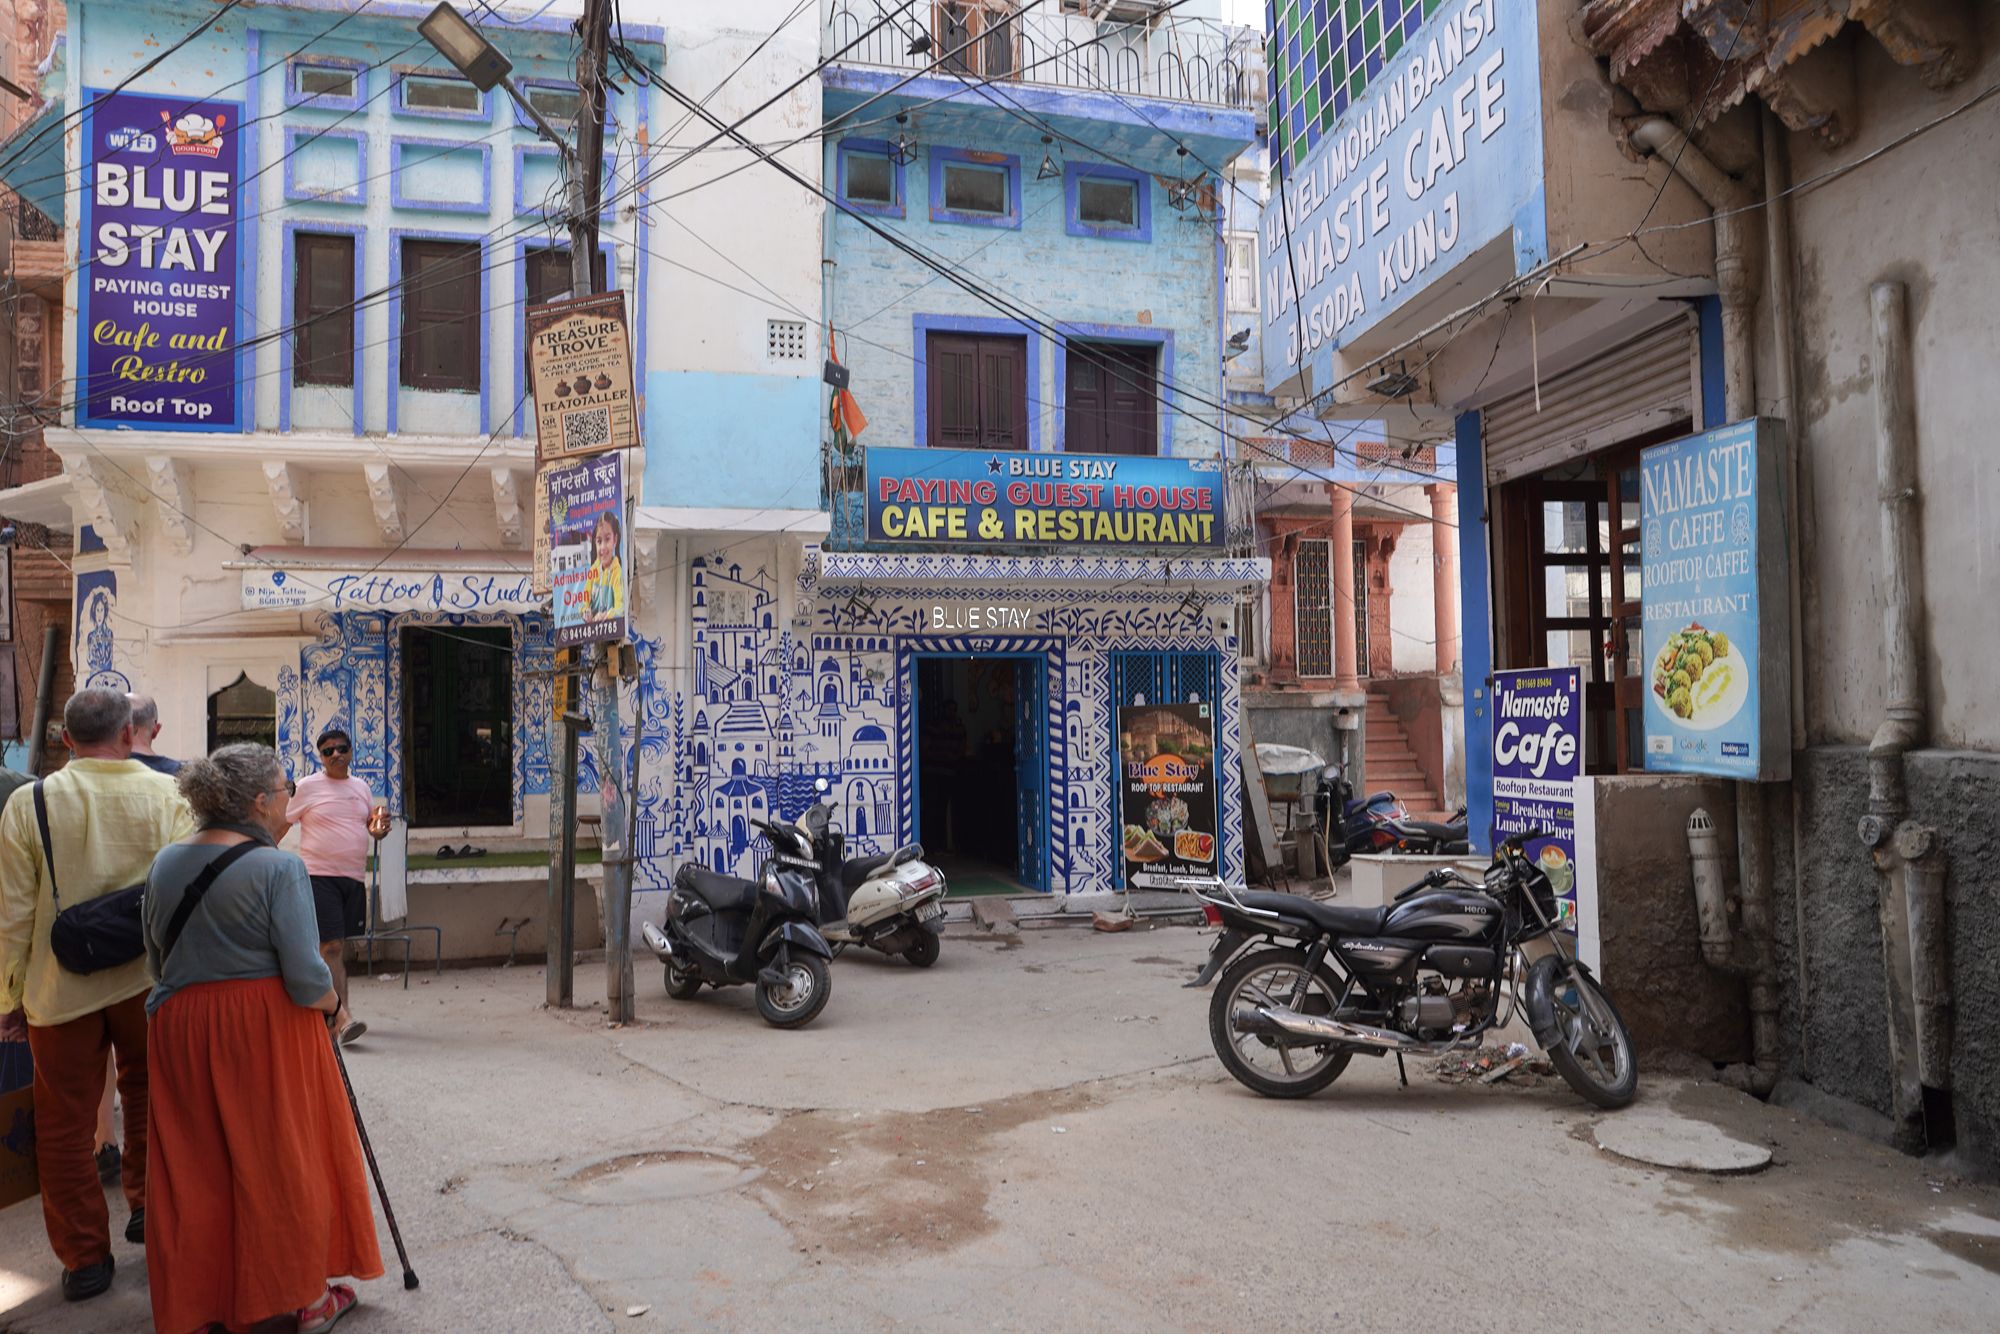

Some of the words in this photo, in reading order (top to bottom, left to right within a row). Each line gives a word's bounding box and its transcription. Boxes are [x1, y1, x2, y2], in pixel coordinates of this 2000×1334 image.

[97, 162, 229, 215] BLUE
[1266, 159, 1390, 327] NAMASTE
[1403, 48, 1506, 201] CAFE
[97, 221, 228, 273] STAY
[94, 277, 163, 297] PAYING
[169, 282, 231, 300] GUEST
[1287, 271, 1366, 368] JASODA
[1378, 191, 1460, 301] KUNJ
[133, 300, 198, 318] HOUSE
[93, 319, 161, 352] Cafe
[169, 326, 228, 351] and
[536, 320, 620, 346] TREASURE
[567, 319, 586, 328] THE
[548, 335, 609, 357] TROVE
[111, 354, 207, 384] Restro
[540, 363, 563, 374] SCAN
[578, 357, 600, 366] CODE
[573, 362, 605, 374] SAFFRON
[110, 396, 166, 415] Roof
[171, 398, 213, 420] Top
[541, 388, 628, 413] TEATOTALLER
[1642, 448, 1669, 461] WELCOME
[1671, 444, 1679, 453] TO
[551, 466, 590, 496] मॉण्टेसरी
[593, 461, 617, 485] स्कूल
[1009, 457, 1062, 479] BLUE
[1069, 459, 1118, 480] STAY
[1643, 440, 1752, 519] NAMASTE
[878, 477, 997, 504] PAYING
[1006, 481, 1105, 508] GUEST
[1113, 485, 1213, 511] HOUSE
[881, 504, 968, 539] CAFE
[977, 508, 1005, 541] &
[1014, 509, 1215, 545] RESTAURANT
[1668, 510, 1726, 551] CAFFE
[553, 567, 599, 588] Admission
[1644, 556, 1702, 588] ROOFTOP
[1705, 549, 1750, 580] CAFFE
[327, 574, 425, 608] Tattoo
[563, 590, 590, 608] Open
[932, 605, 980, 630] BLUE
[986, 605, 1032, 630] STAY
[1645, 592, 1750, 622] RESTAURANT
[569, 621, 618, 641] 94148-17765
[1501, 688, 1570, 720] Namaste
[1495, 721, 1576, 778] Cafe
[1680, 738, 1709, 754] Google
[1722, 743, 1748, 756] Booking.com
[1128, 761, 1159, 779] Blue
[1165, 761, 1200, 780] Stay
[1131, 783, 1148, 793] ROOF
[1149, 783, 1162, 793] TOP
[1163, 782, 1204, 793] RESTAURANT
[1496, 780, 1527, 795] Rooftop
[1528, 782, 1573, 798] Restaurant
[1512, 800, 1554, 820] Breakfast
[1496, 814, 1527, 834] Lunch
[1542, 819, 1574, 841] Diner
[1464, 905, 1487, 914] Hero
